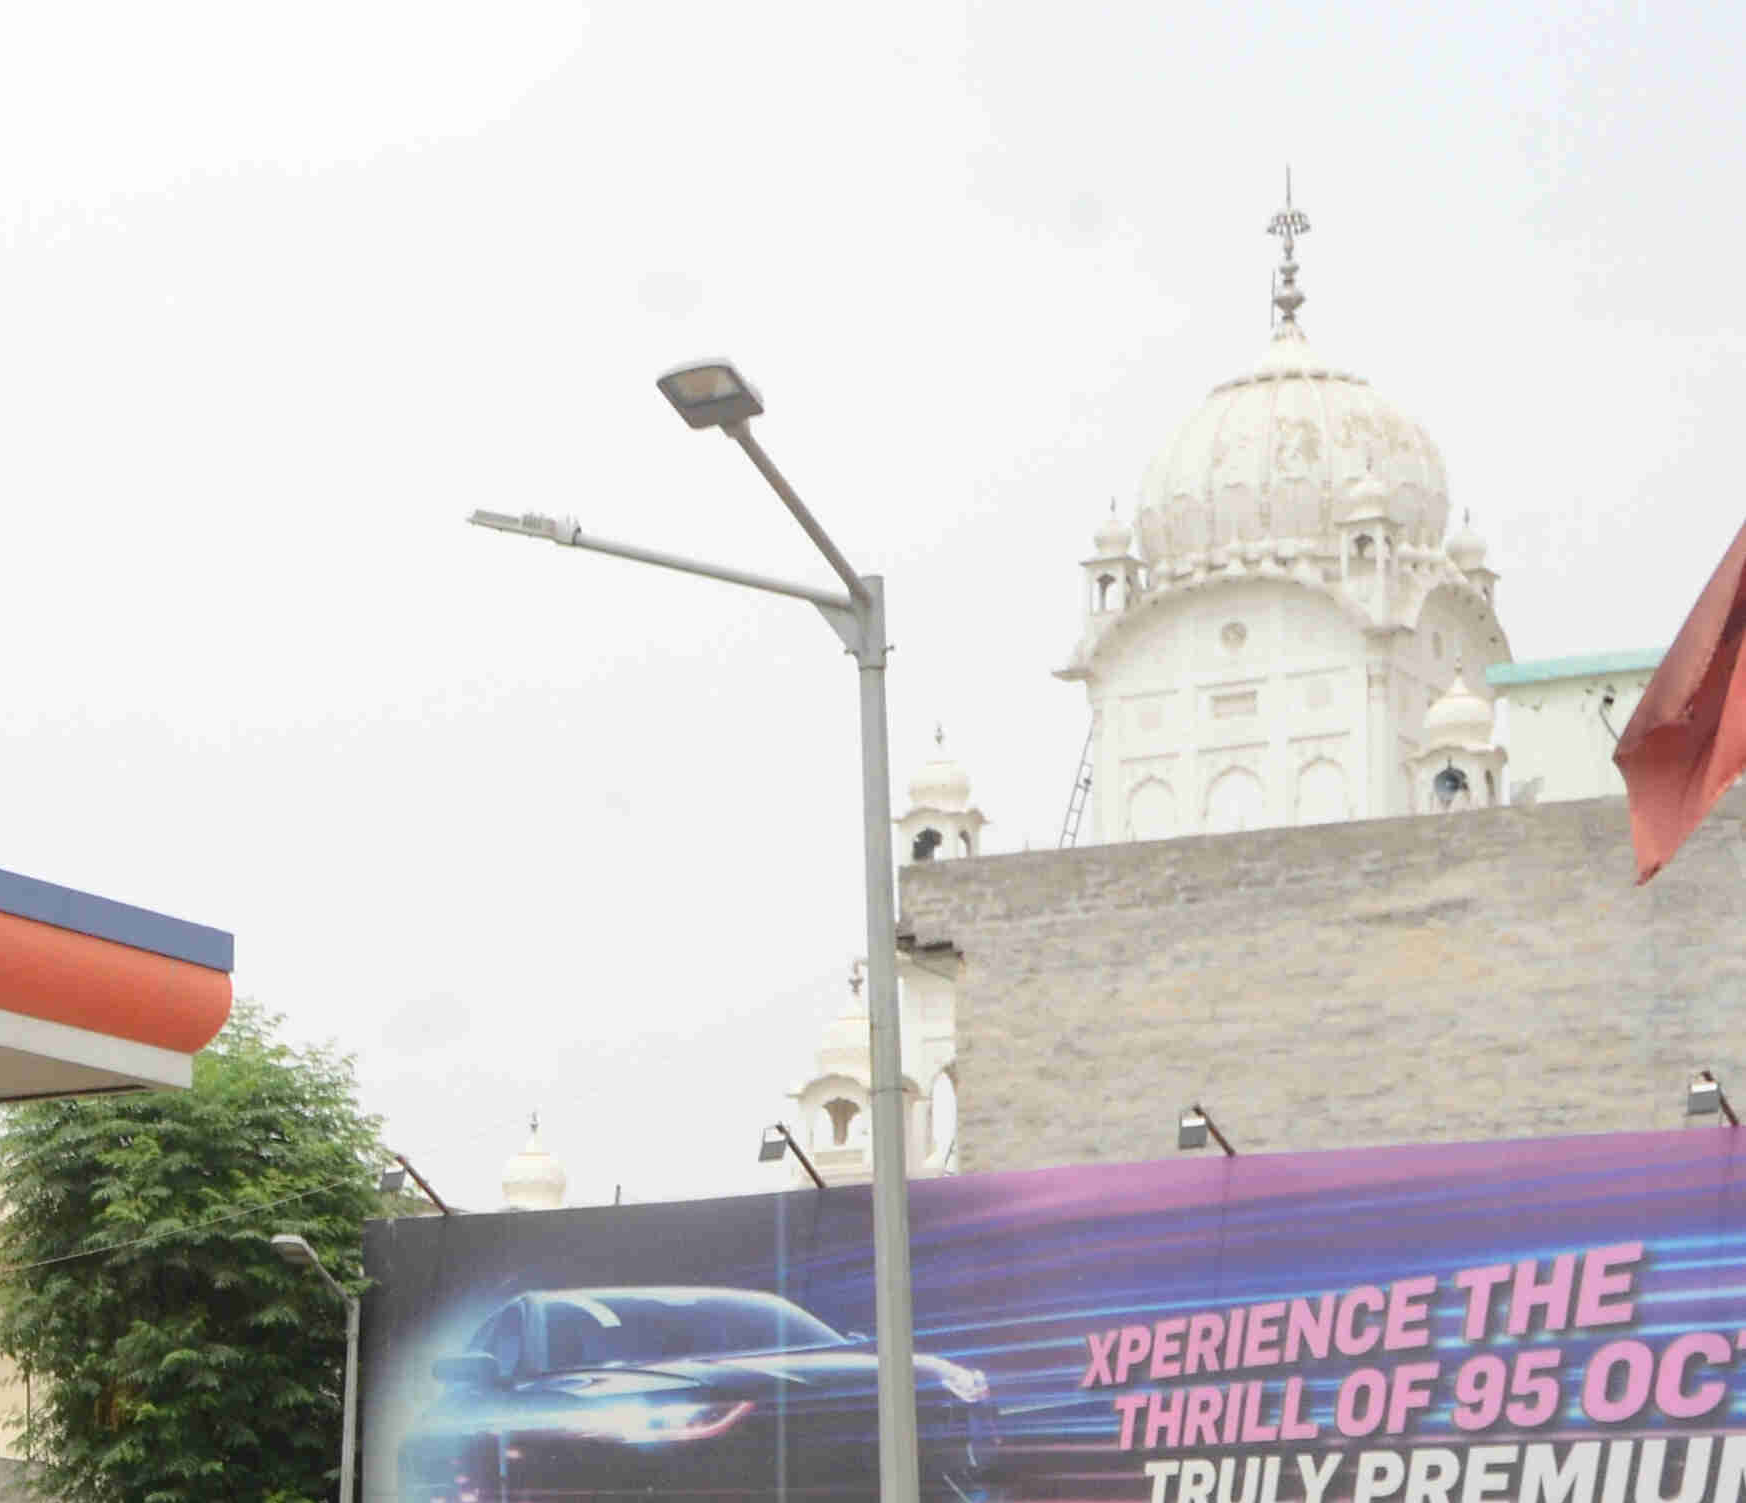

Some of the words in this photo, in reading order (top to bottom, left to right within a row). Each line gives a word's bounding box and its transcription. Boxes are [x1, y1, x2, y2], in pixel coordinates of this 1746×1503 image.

[1080, 1275, 1438, 1388] XPERIENCE
[1456, 1242, 1644, 1342] THE
[1113, 1385, 1319, 1452] THRILL
[1335, 1361, 1440, 1437] OF
[1454, 1349, 1561, 1431] 95
[1581, 1329, 1746, 1424] OC
